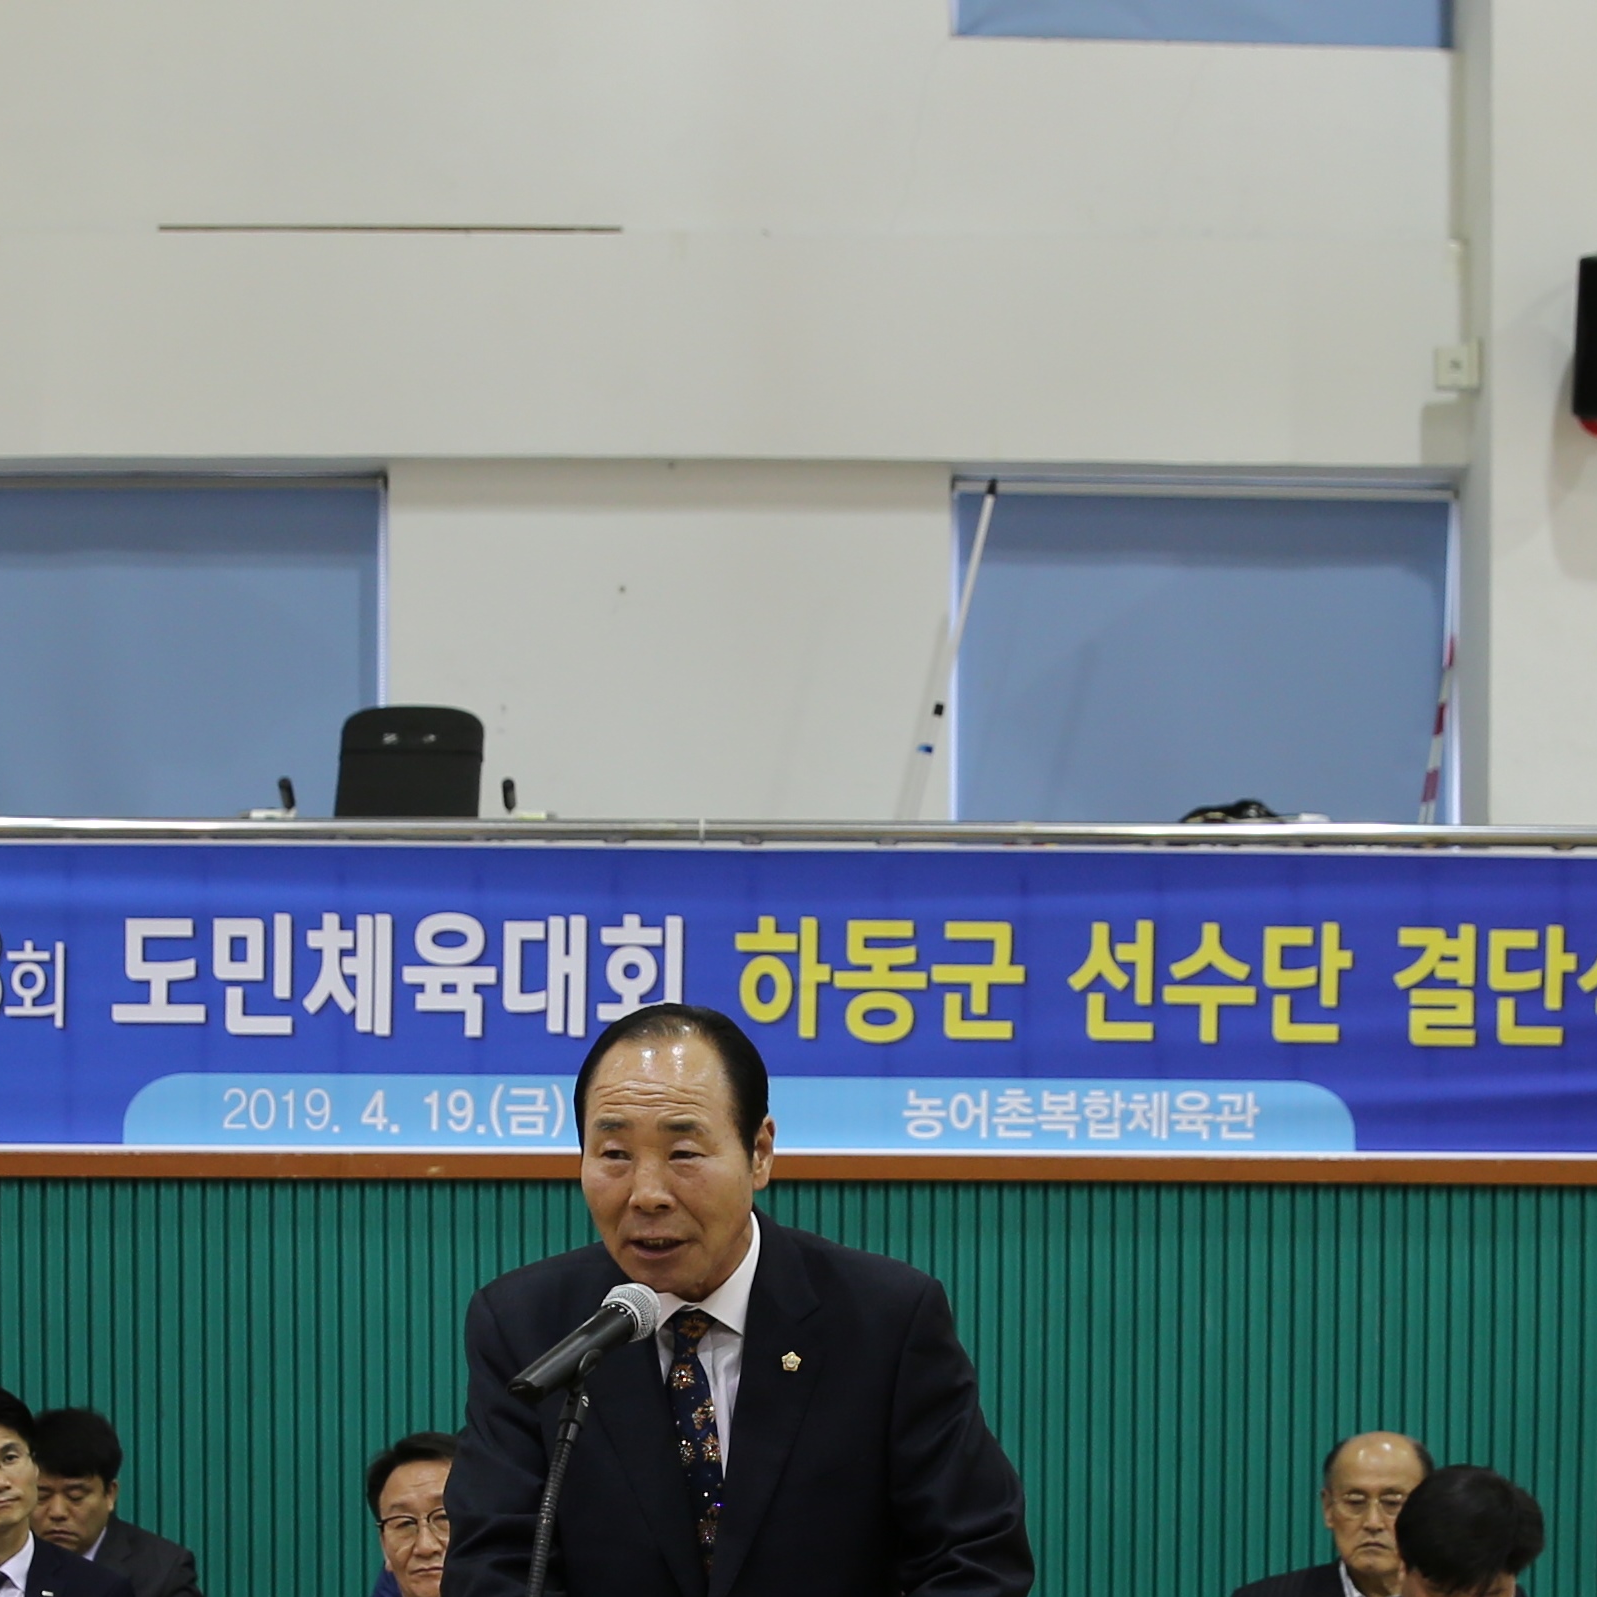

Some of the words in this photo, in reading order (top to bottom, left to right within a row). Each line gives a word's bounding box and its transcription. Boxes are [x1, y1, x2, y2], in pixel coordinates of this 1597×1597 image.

[110, 911, 685, 1038] 도민체육대회
[734, 915, 1026, 1044] 하동군
[1067, 919, 1354, 1044] 선수단
[221, 1086, 341, 1133] 2019.
[359, 1087, 401, 1134] 4.
[422, 1083, 566, 1138] 19.(금)
[901, 1087, 1261, 1141] 농어촌복합체육관
